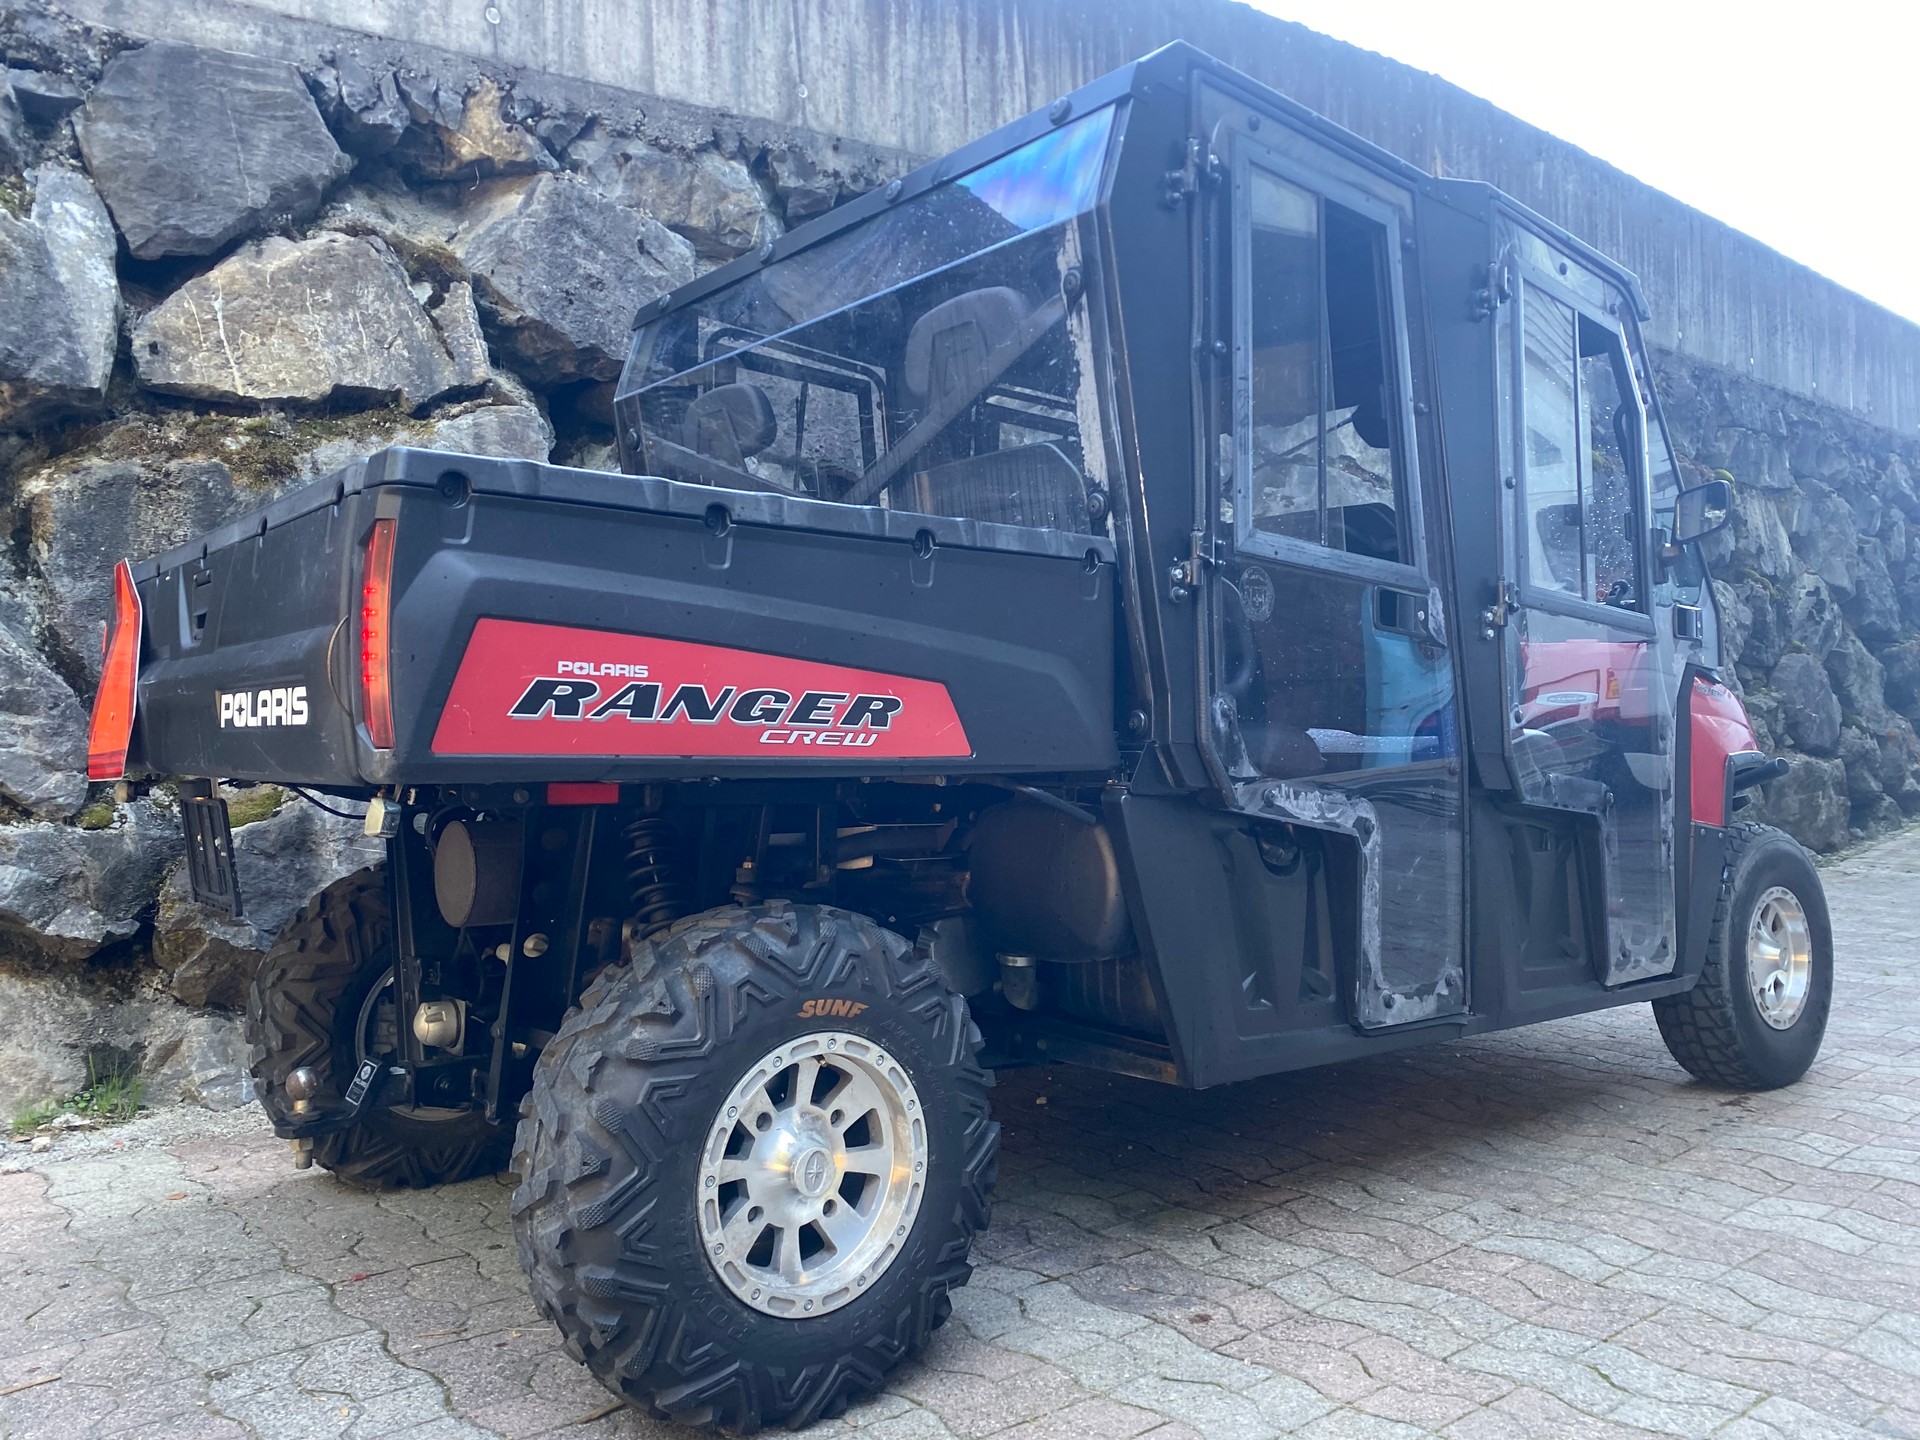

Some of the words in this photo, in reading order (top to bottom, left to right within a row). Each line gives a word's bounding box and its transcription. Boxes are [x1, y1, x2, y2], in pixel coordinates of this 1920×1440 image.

[557, 661, 649, 678] POLARIS
[220, 686, 308, 728] POLARIS
[507, 677, 903, 730] RANGER
[759, 729, 879, 747] CREW
[796, 999, 870, 1018] SUNF
